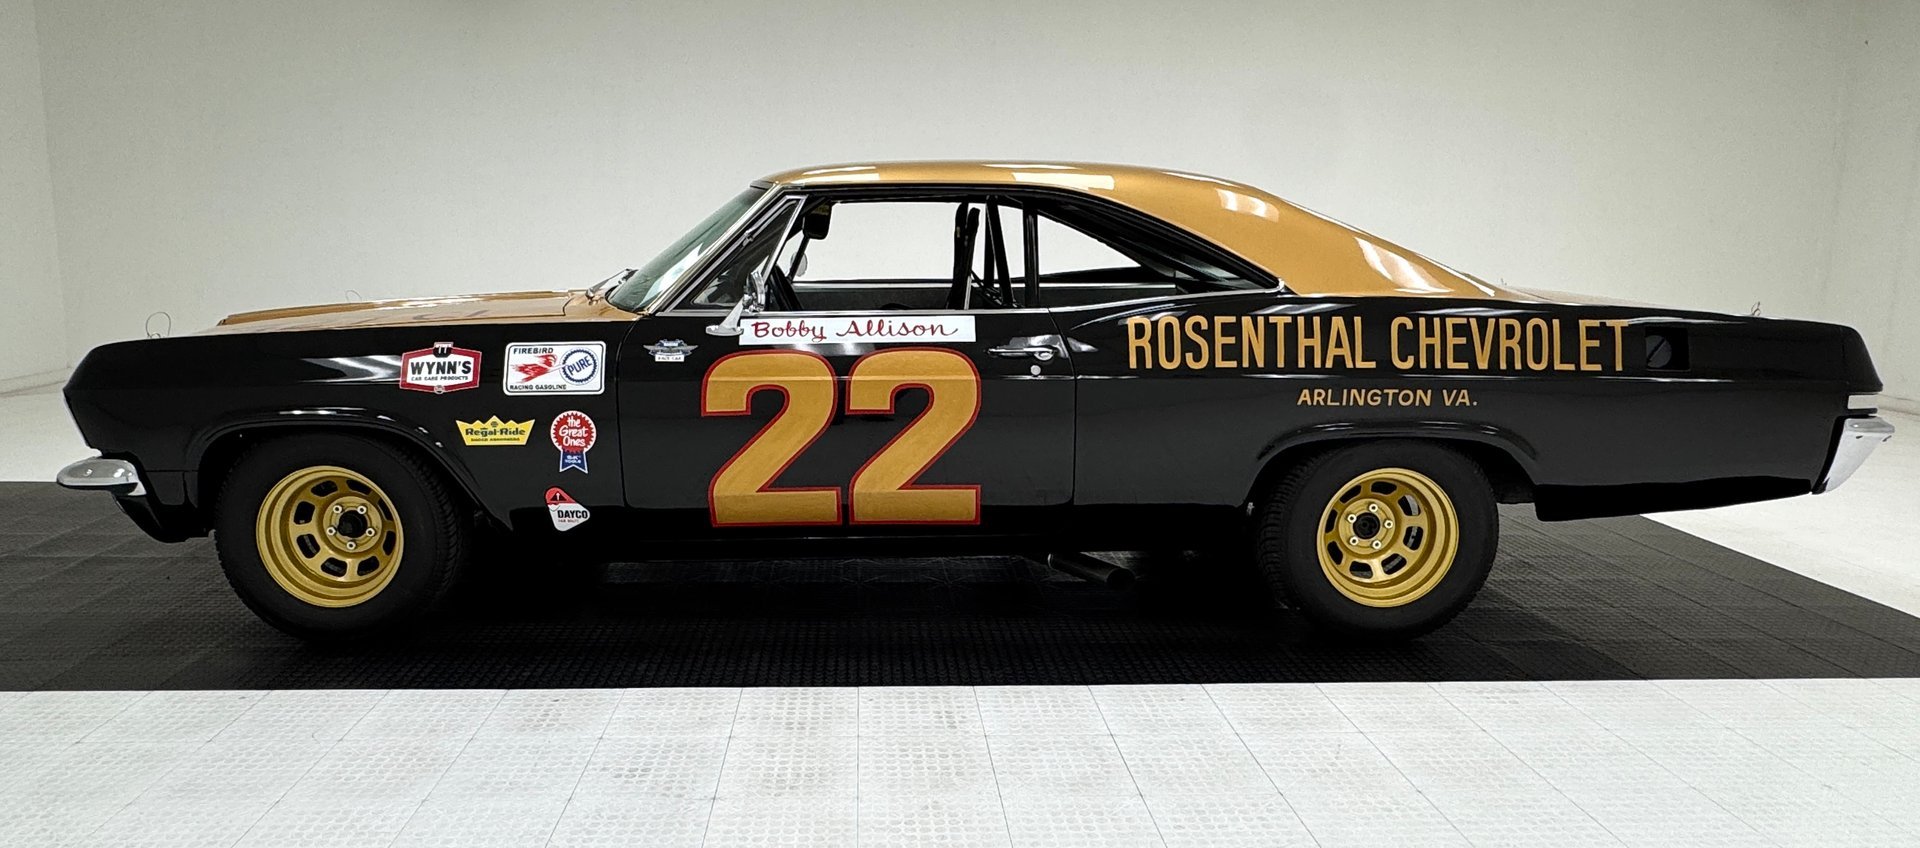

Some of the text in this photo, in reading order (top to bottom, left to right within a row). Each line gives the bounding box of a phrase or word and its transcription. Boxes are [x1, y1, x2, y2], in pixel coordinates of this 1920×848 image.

[750, 319, 959, 342] Bobby Allison
[1127, 315, 1630, 371] ROSENTHAL CHEVROLET
[513, 347, 554, 355] FIREBIRD
[410, 360, 472, 375] WYNN'S
[567, 355, 592, 376] PURE
[1296, 388, 1478, 407] ARLINGTON VA.
[567, 415, 582, 428] the
[465, 427, 526, 437] Regal-Ride
[558, 424, 589, 437] Great
[701, 347, 982, 527] 22
[562, 436, 586, 447] Ones
[557, 510, 588, 519] DAYCO
